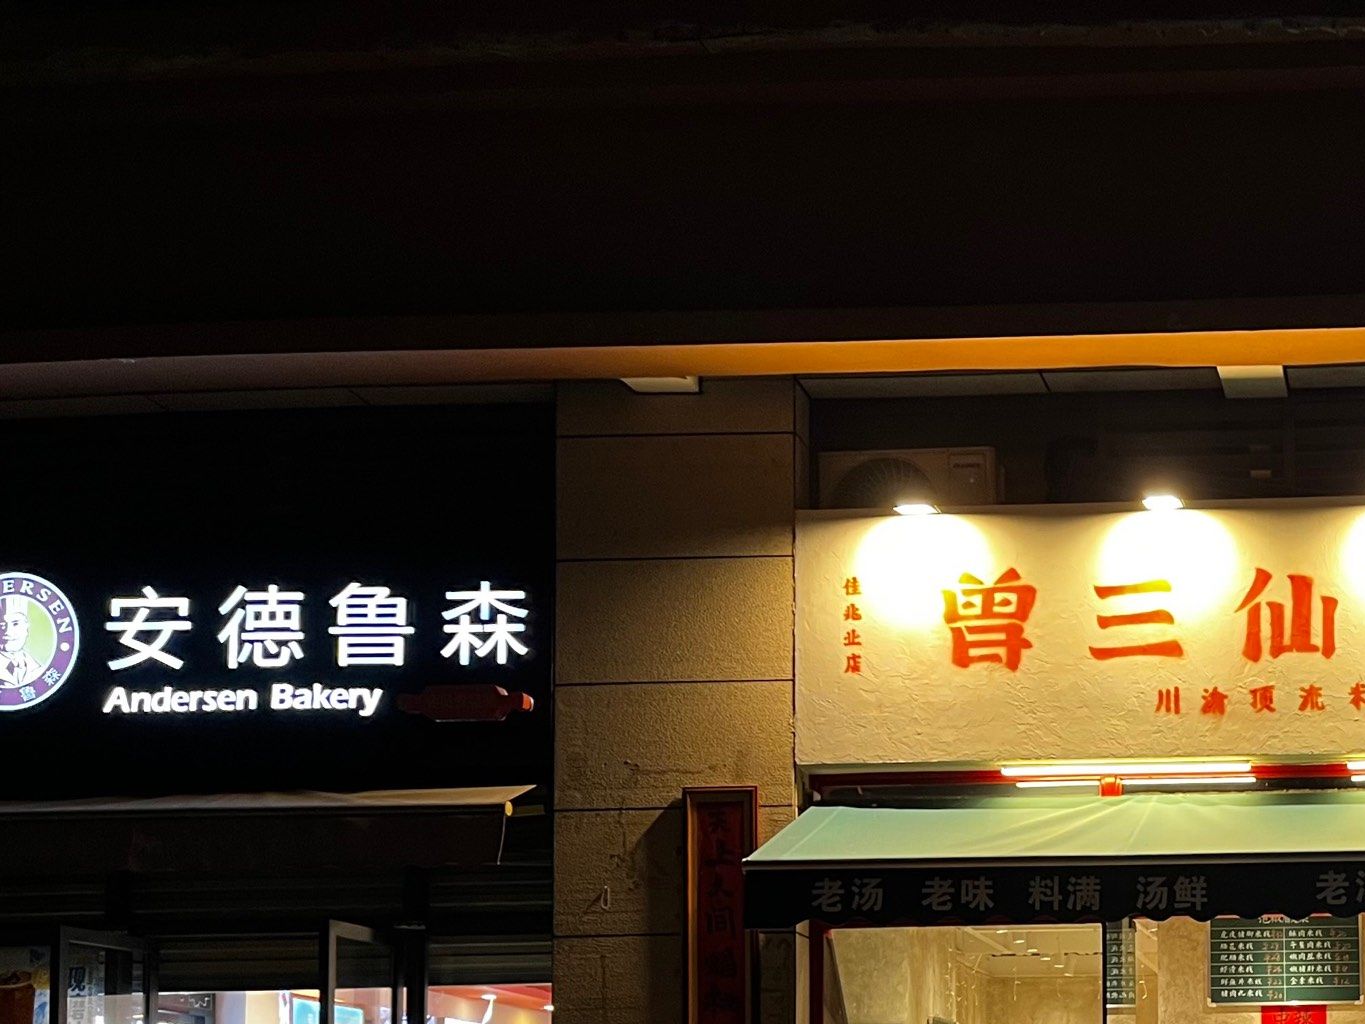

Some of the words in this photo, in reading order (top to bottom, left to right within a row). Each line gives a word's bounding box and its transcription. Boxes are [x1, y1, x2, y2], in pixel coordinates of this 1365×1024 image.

[1, 579, 73, 634] ERSEN
[105, 581, 529, 670] 安德鲁森
[843, 577, 862, 673] 佳兆业店
[103, 686, 258, 713] Andersen
[270, 684, 383, 716] Bakery
[811, 876, 884, 912] 老汤
[921, 876, 996, 911] 老味
[1028, 875, 1100, 911] 料满
[1135, 875, 1209, 910] 汤鲜
